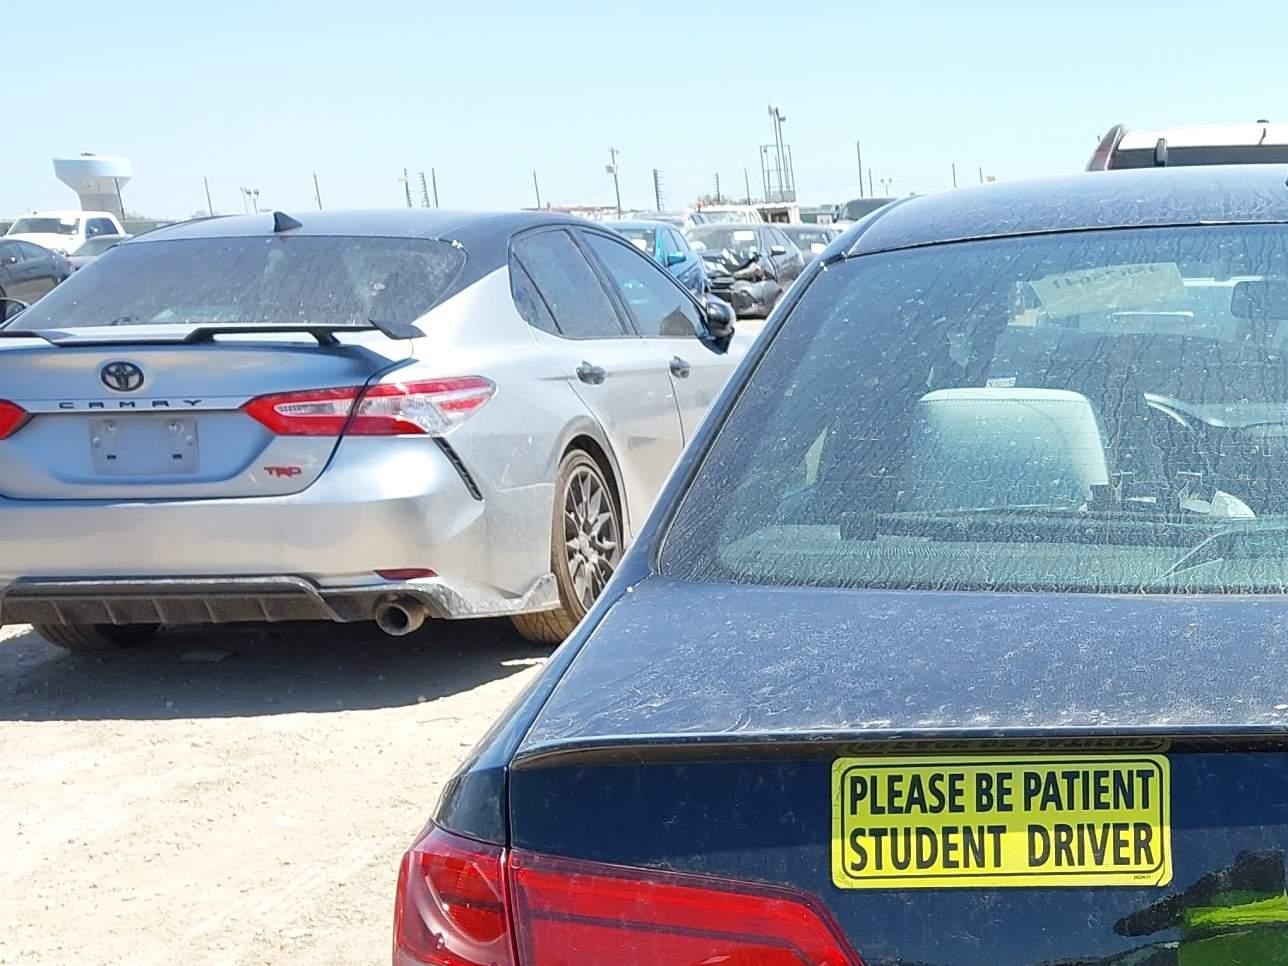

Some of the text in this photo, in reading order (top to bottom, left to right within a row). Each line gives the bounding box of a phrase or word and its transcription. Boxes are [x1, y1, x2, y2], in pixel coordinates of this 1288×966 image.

[59, 399, 202, 409] CAMRY
[263, 466, 302, 477] TRD
[850, 769, 1155, 815] PLEASE BE PATIENT
[850, 822, 1155, 871] STUDENT DRIVER
